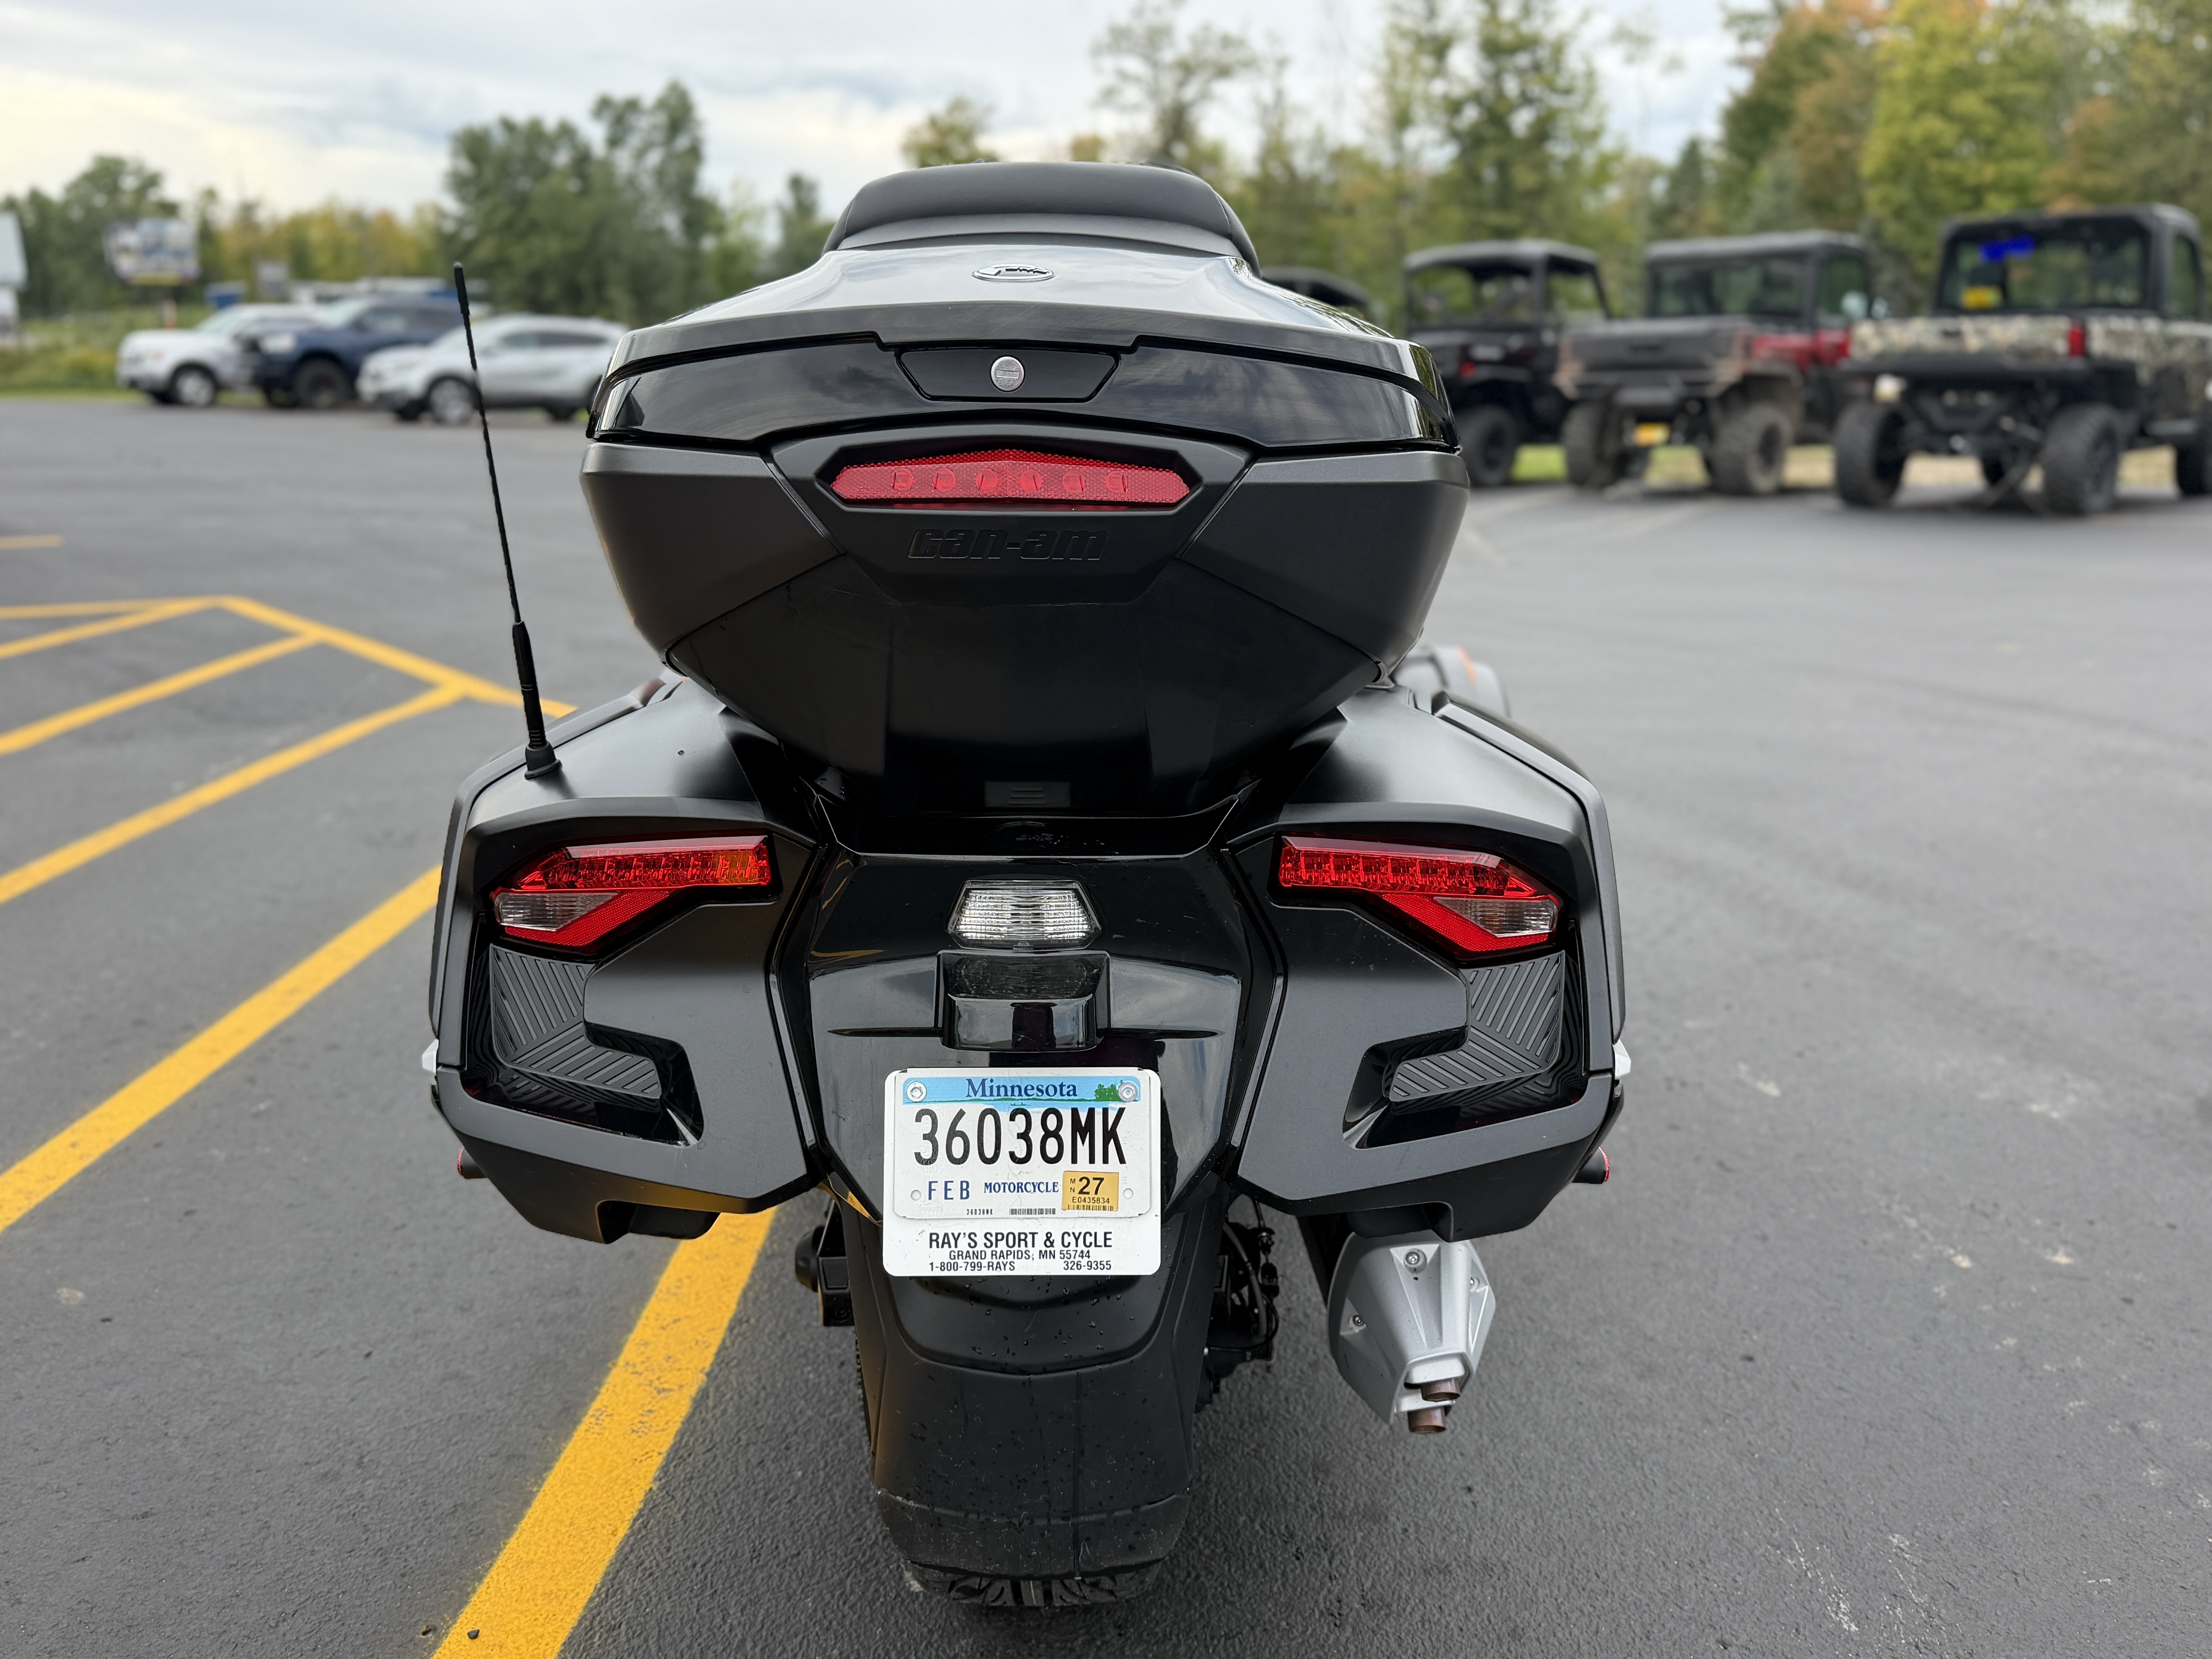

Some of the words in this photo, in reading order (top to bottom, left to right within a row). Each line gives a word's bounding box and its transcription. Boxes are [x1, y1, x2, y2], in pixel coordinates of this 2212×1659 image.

[908, 529, 1108, 560] can-am
[966, 1079, 1078, 1097] Minnesota
[914, 1107, 1127, 1165] 36038MK
[928, 1180, 970, 1200] FEB
[984, 1182, 1059, 1193] MOTORCYCLE
[1078, 1176, 1104, 1195] 27
[929, 1232, 977, 1249] RAY'S
[984, 1232, 1039, 1249] SPORT
[1044, 1231, 1055, 1248] &
[1061, 1231, 1113, 1248] CYCLE
[949, 1250, 987, 1260] GRAND
[991, 1250, 1034, 1262] RAPIDS,
[1039, 1250, 1056, 1259] MN
[1060, 1250, 1091, 1260] 55744
[929, 1261, 1015, 1271] 1-800-799-RAYS
[1063, 1261, 1112, 1271] 326-9355
